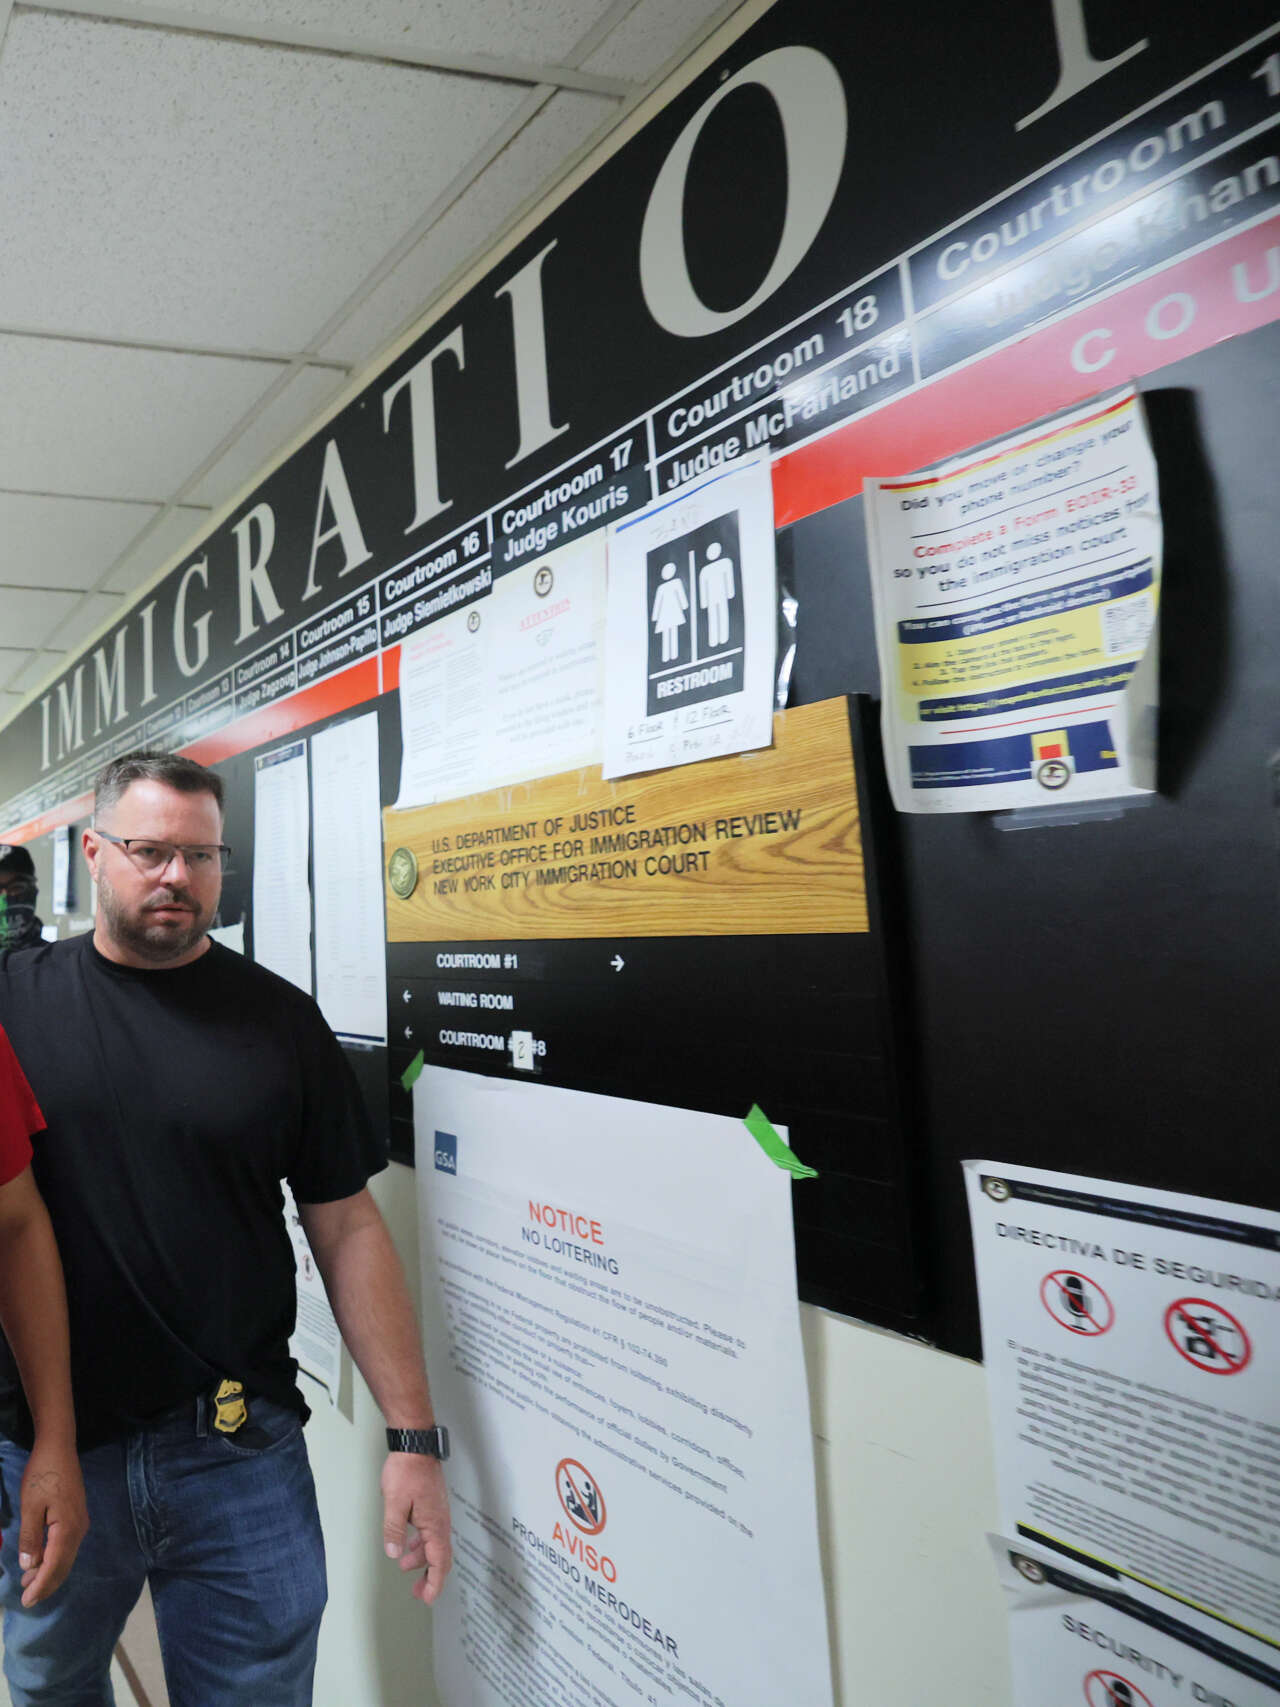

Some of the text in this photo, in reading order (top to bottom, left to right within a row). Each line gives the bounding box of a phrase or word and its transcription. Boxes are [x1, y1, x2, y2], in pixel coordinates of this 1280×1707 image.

[936, 100, 1225, 281] Courtroom
[40, 0, 1149, 771] IMMIGRATIO
[667, 296, 879, 438] Courtroom 18
[667, 344, 904, 489] Judge McFarland
[502, 463, 604, 534] Courtroom
[610, 439, 633, 472] 17
[900, 420, 1134, 512] Did you move or change your
[959, 461, 1081, 515] phone number?
[504, 522, 559, 562] Judge
[562, 485, 630, 534] Kouris
[893, 566, 913, 579] so
[916, 562, 951, 580] you
[956, 555, 977, 569] do
[981, 545, 1007, 561] not
[1011, 530, 1050, 551] miss
[1055, 509, 1121, 537] notices
[912, 530, 994, 559] Complete
[1013, 508, 1059, 529] Form
[384, 531, 481, 601] Courtroom 16
[938, 527, 1128, 592] the immigration court
[300, 595, 371, 648] Courtroom 15
[383, 608, 414, 639] Judge
[237, 642, 291, 685] Courtroom 14
[298, 656, 319, 680] Judge
[656, 661, 734, 699] RESTROOM
[431, 805, 637, 854] U.S. DEPARTMENT OF JUSTICE
[432, 808, 803, 875] EXECUTIVE OFFICE FOR IMMIGRATION REVIEW
[433, 851, 712, 896] NEW YORK CITY IMMIGRATION COURT
[436, 953, 518, 969] COURTROOM #1
[437, 991, 514, 1010] WAITING ROOM
[439, 1029, 505, 1051] COURTROOM
[435, 1149, 456, 1170] GSA
[528, 1200, 605, 1246] NOTICE
[995, 1221, 1108, 1262] DIRECTIVA
[1112, 1248, 1148, 1271] DE
[521, 1227, 542, 1246] NO
[544, 1234, 620, 1276] LOITERING
[552, 1521, 618, 1584] AVISO
[512, 1516, 582, 1584] PROHIBIDO
[584, 1573, 680, 1659] MERODEAR
[1061, 1612, 1184, 1689] SECURITY
